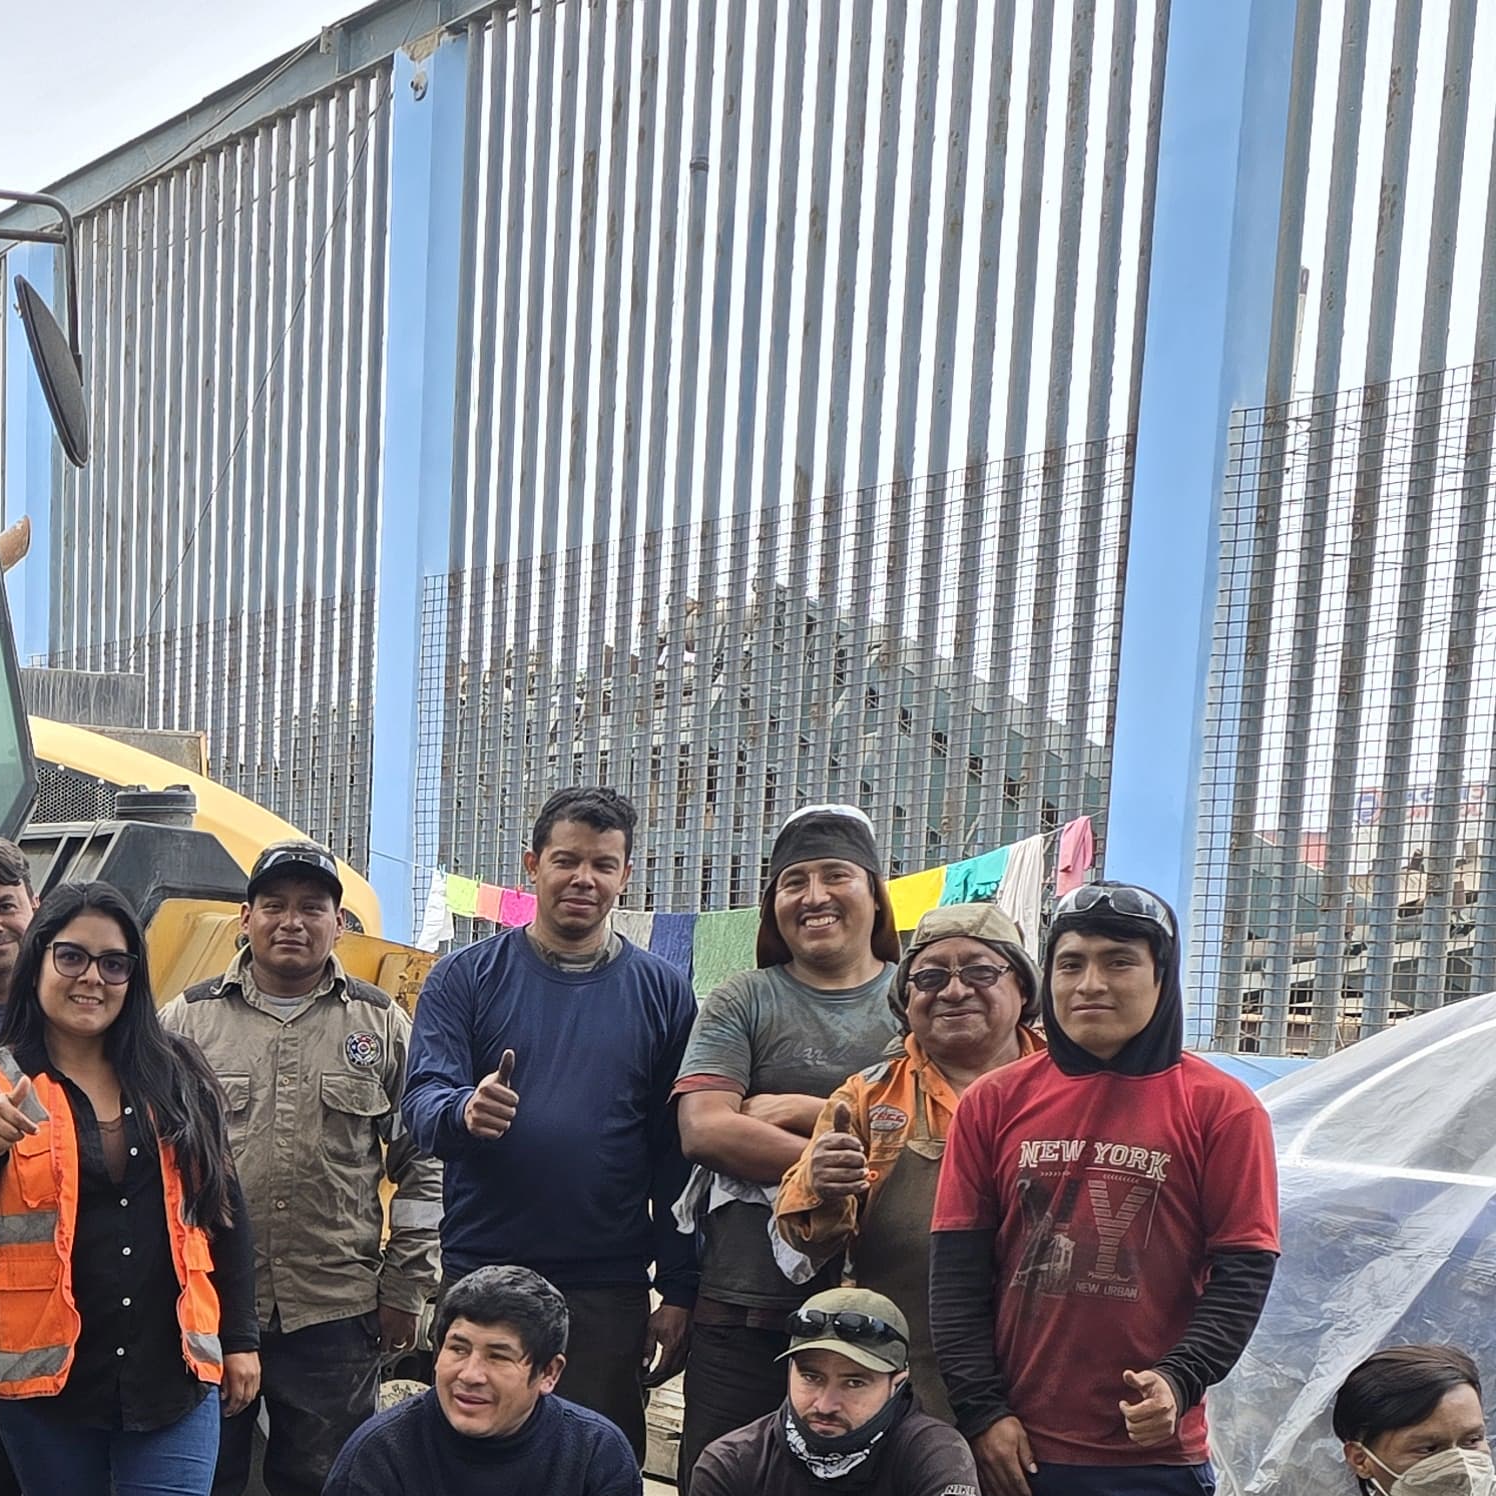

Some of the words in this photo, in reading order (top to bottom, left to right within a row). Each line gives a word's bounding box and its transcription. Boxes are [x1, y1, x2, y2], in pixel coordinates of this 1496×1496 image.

[1018, 1139, 1087, 1169] NEW
[1092, 1142, 1172, 1182] YORK
[1075, 1280, 1100, 1295] NEW
[1104, 1284, 1139, 1301] URBAN
